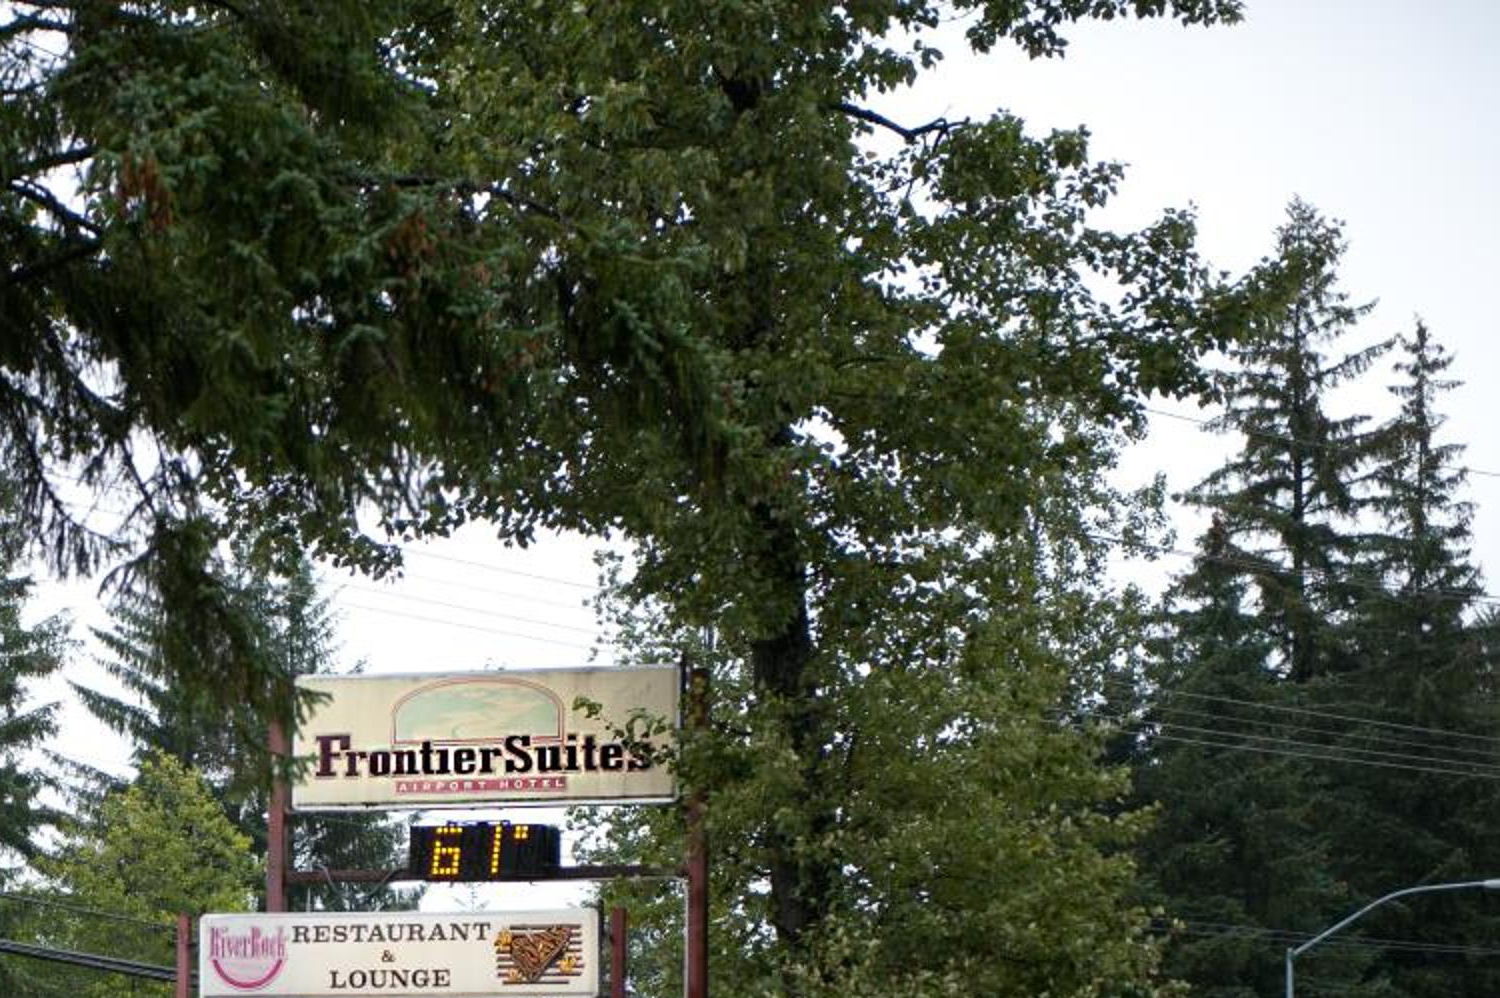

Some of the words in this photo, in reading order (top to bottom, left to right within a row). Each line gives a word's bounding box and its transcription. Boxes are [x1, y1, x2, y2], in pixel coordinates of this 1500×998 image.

[399, 780, 488, 792] AIRPORT
[499, 778, 565, 789] HOTEL
[292, 922, 492, 943] RESTAURANT
[381, 949, 395, 964] &
[330, 968, 452, 989] LOUNGE
